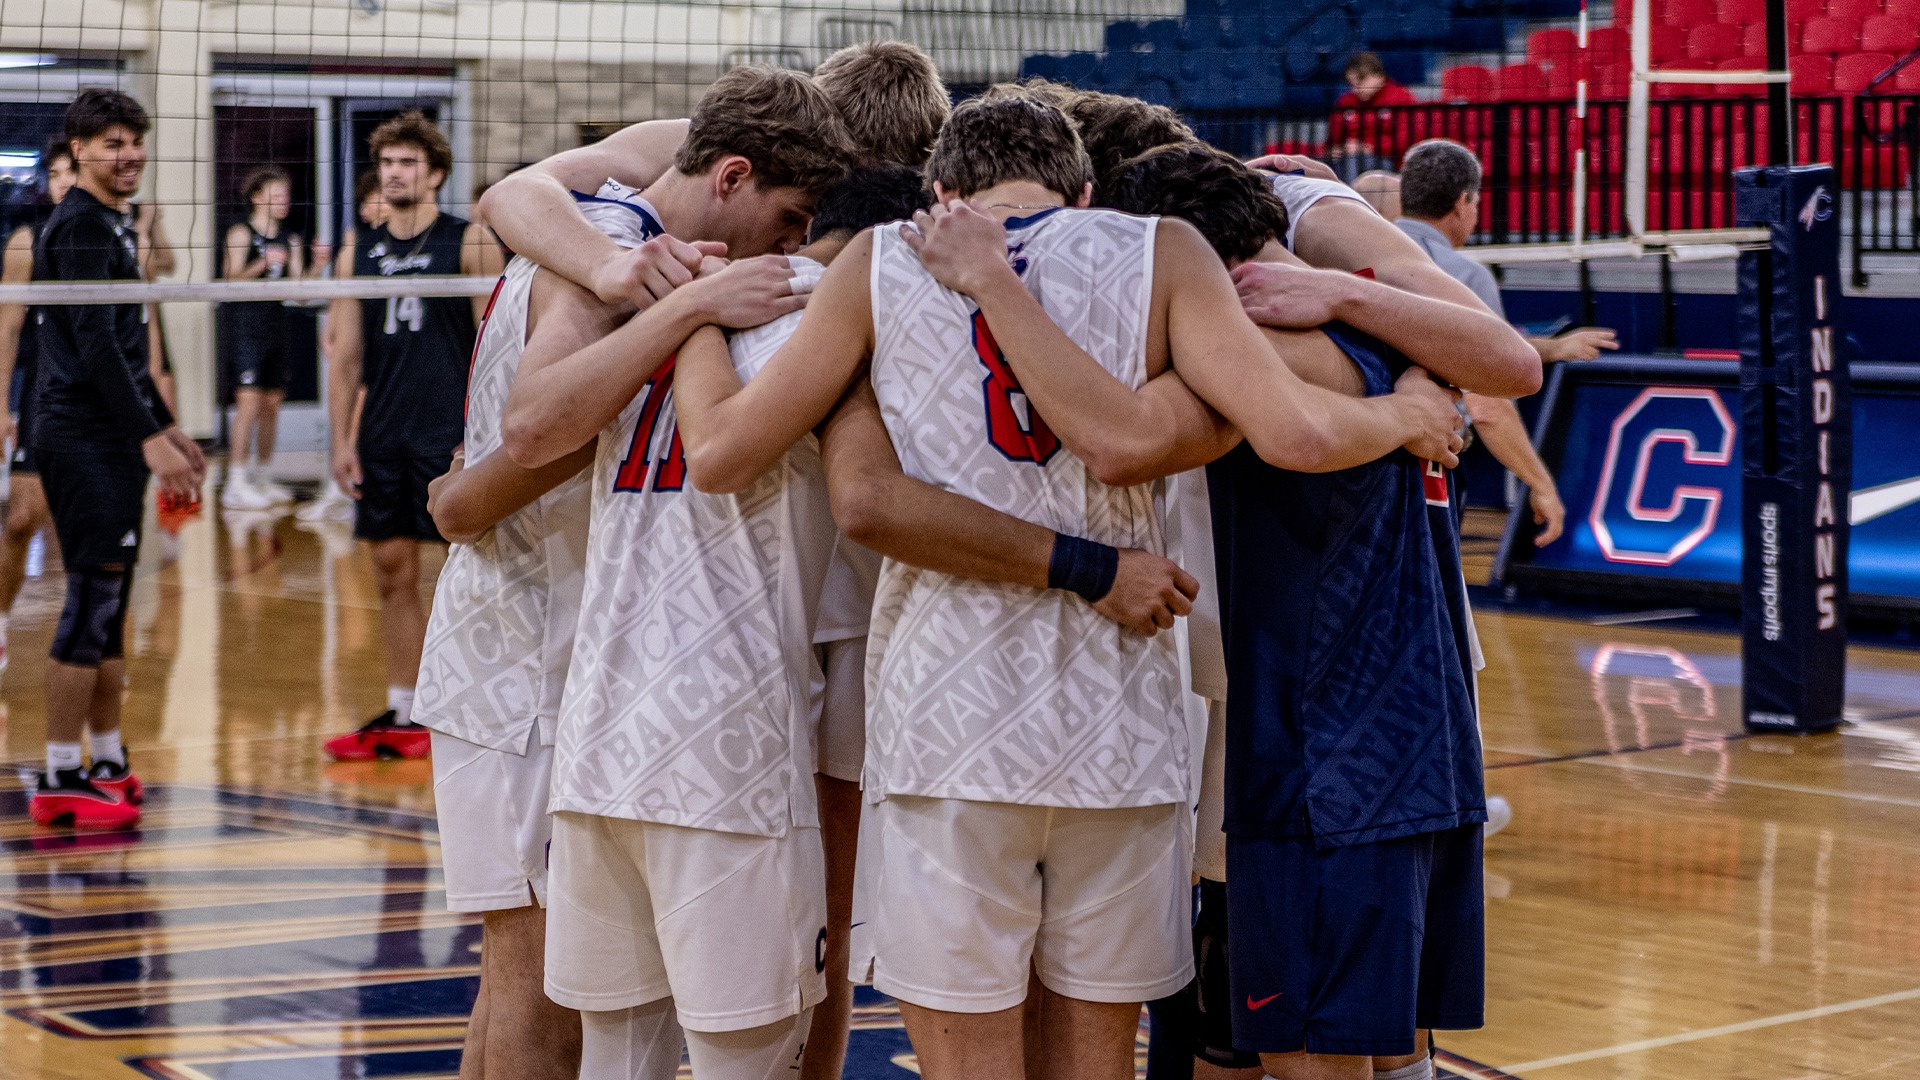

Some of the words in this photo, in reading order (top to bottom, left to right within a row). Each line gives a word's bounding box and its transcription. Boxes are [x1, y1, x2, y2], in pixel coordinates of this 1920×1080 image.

[384, 296, 422, 334] 14
[1590, 386, 1736, 566] C
[1811, 275, 1837, 631] INDIANS
[1760, 502, 1780, 566] sports
[1760, 569, 1782, 640] imports
[886, 617, 1068, 794] CATAWBA
